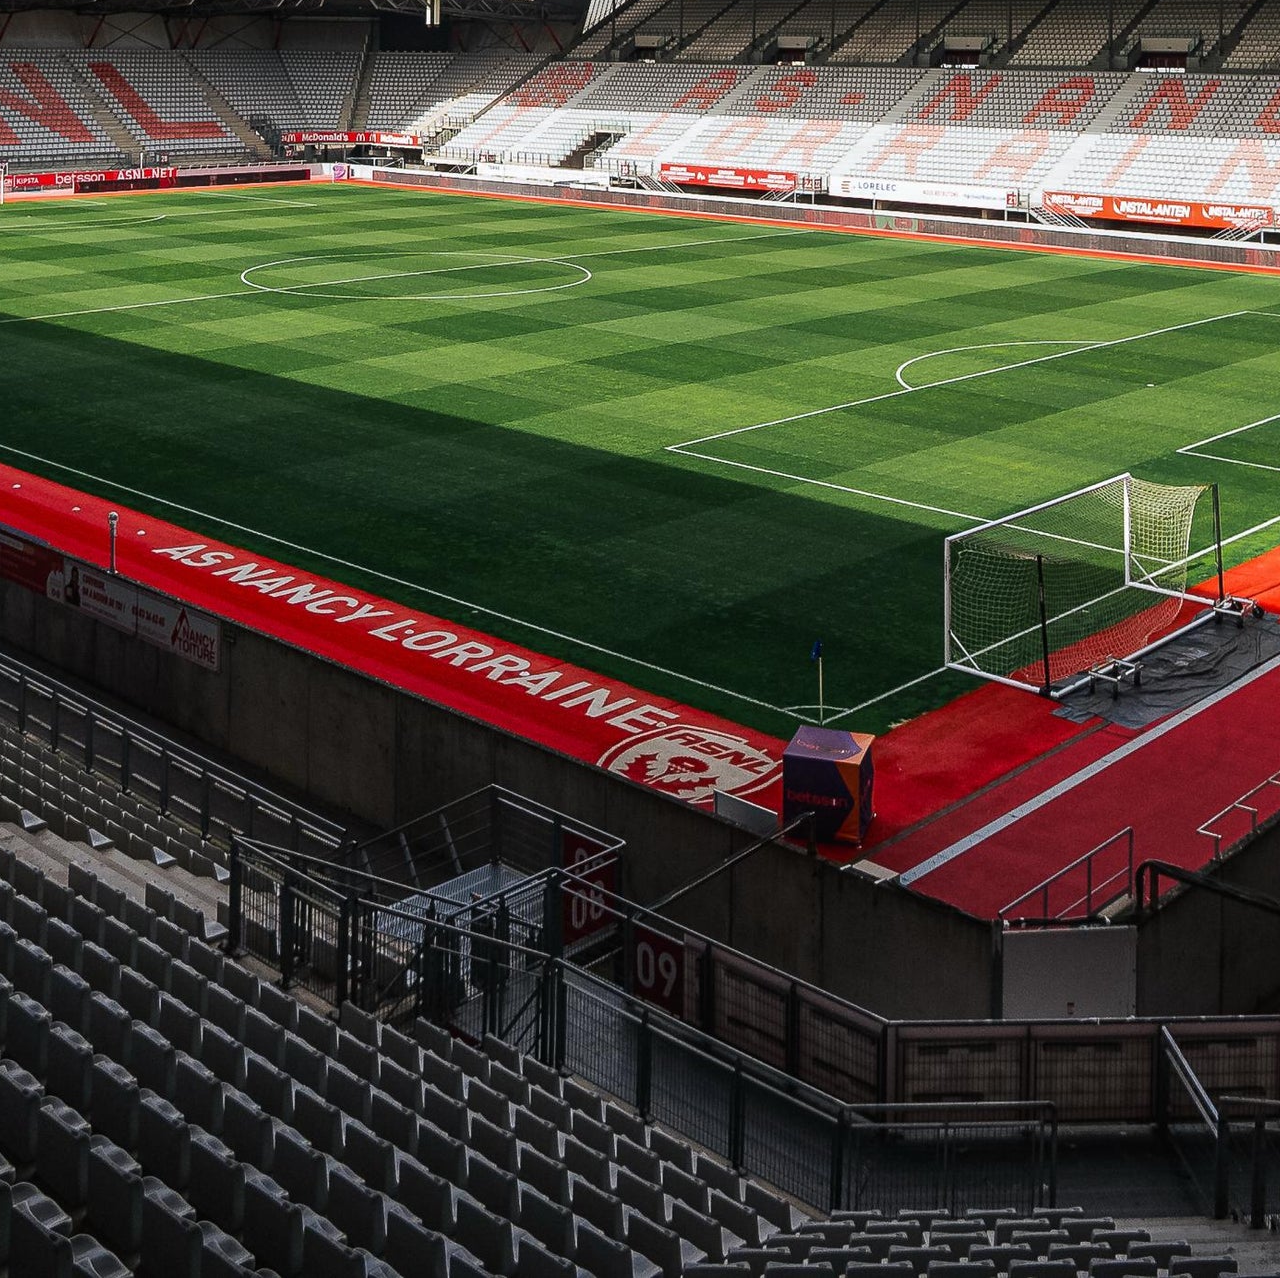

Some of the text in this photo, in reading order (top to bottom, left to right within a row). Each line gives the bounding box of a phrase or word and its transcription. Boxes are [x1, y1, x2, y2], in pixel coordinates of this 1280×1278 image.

[302, 132, 349, 142] McDonald's
[55, 172, 106, 185] betsson
[117, 167, 174, 180] ASNL.NET
[857, 181, 897, 192] LORELEC
[150, 543, 237, 567] AS
[211, 562, 396, 624] NANCY
[182, 626, 215, 649] NANCY
[177, 636, 216, 664] TOITURE
[636, 941, 678, 998] 09
